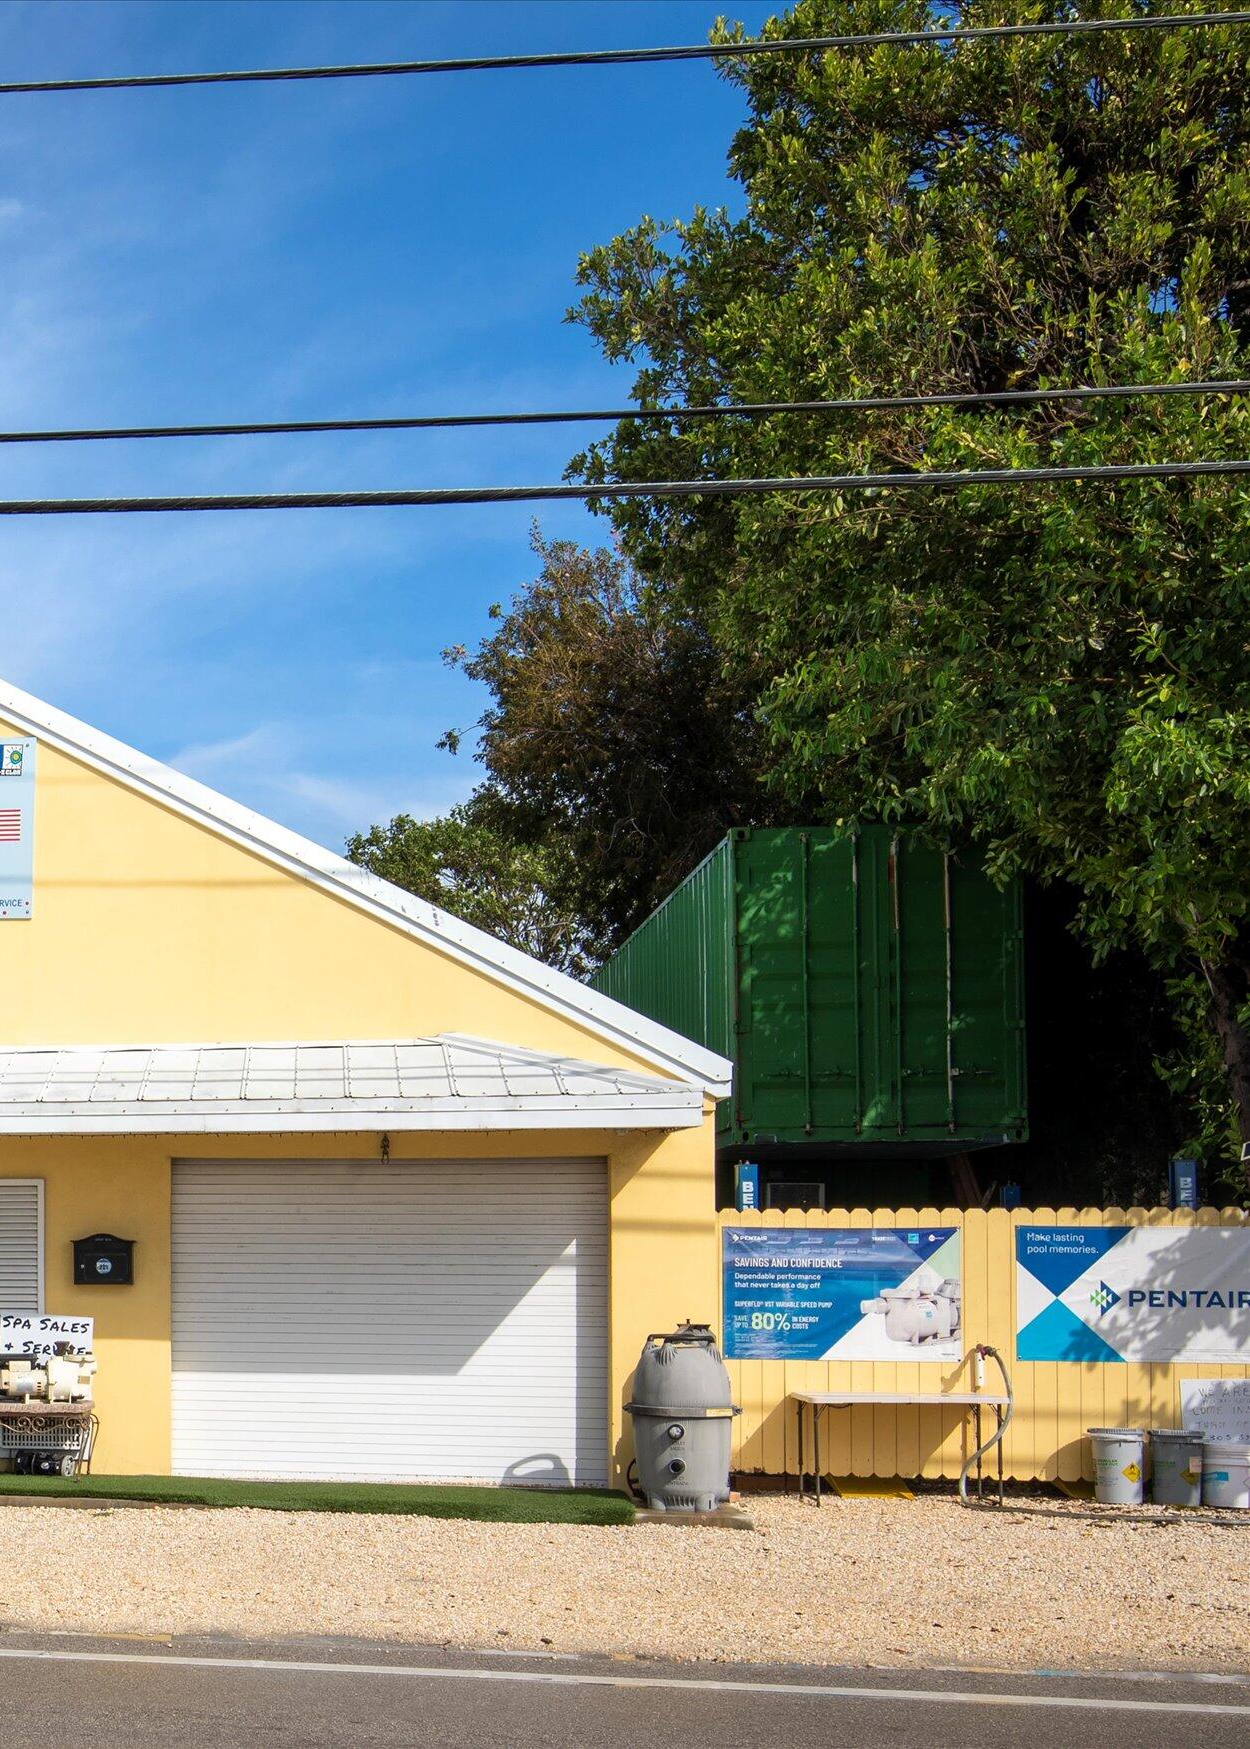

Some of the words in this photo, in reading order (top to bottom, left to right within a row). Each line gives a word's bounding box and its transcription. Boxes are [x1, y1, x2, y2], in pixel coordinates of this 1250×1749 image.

[1027, 1233, 1051, 1241] Make
[1053, 1233, 1085, 1244] lasting
[1027, 1246, 1047, 1255] pool
[1049, 1246, 1099, 1254] memories.
[734, 1258, 769, 1267] SAVINGS
[771, 1258, 788, 1267] AND
[790, 1258, 843, 1268] CONFIDENCE
[1129, 1290, 1250, 1308] PENTAIR
[2, 1316, 31, 1329] SPA
[40, 1318, 89, 1333] SALES
[752, 1312, 791, 1330] 80%
